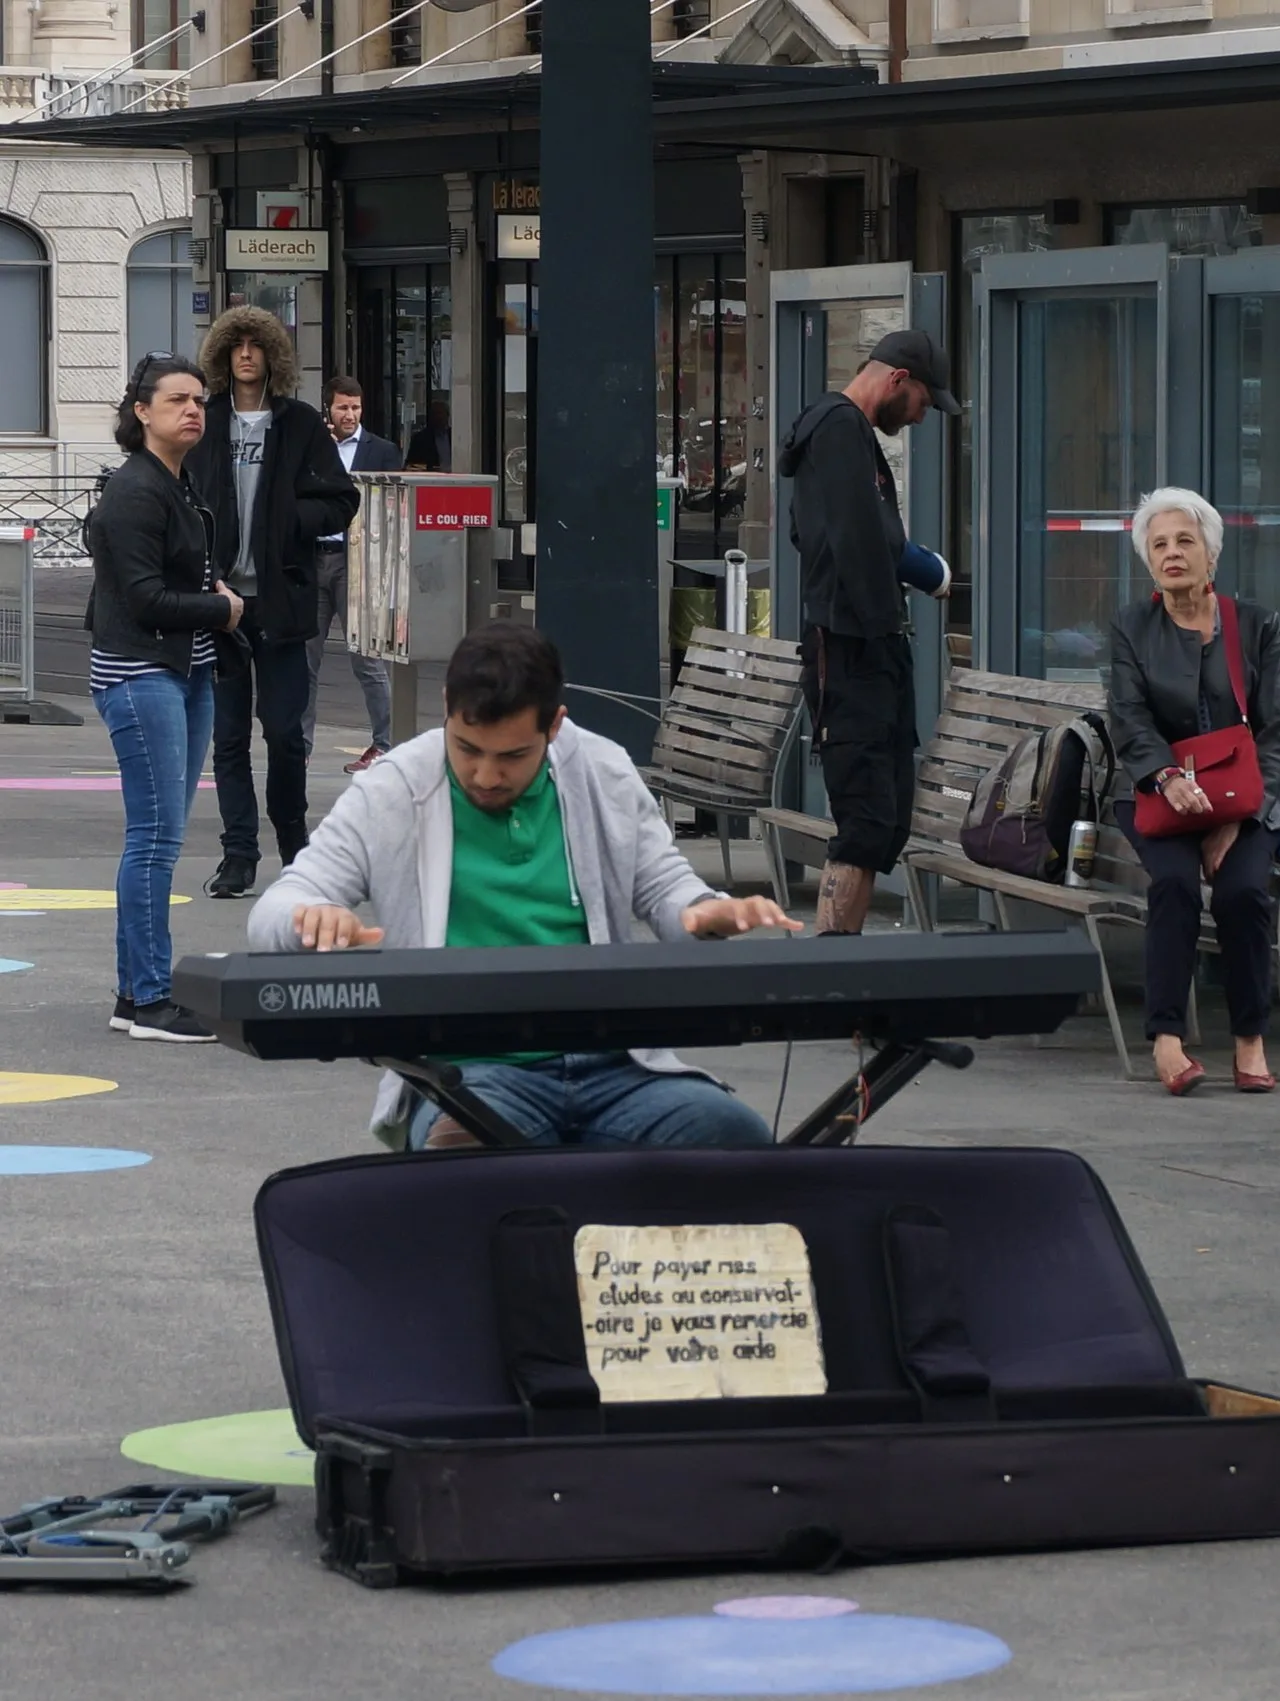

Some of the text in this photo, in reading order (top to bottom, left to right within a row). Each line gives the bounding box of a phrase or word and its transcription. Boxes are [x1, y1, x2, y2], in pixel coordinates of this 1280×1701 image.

[238, 239, 316, 254] Läderach
[418, 514, 488, 525] LE COURIER
[288, 982, 381, 1010] YAMAHA
[591, 1251, 642, 1280] Pour
[653, 1259, 712, 1282] payer
[672, 1290, 695, 1305] au
[638, 1312, 663, 1343] je
[671, 1316, 716, 1334] vous
[601, 1345, 651, 1371] pour
[733, 1331, 777, 1360] aide
